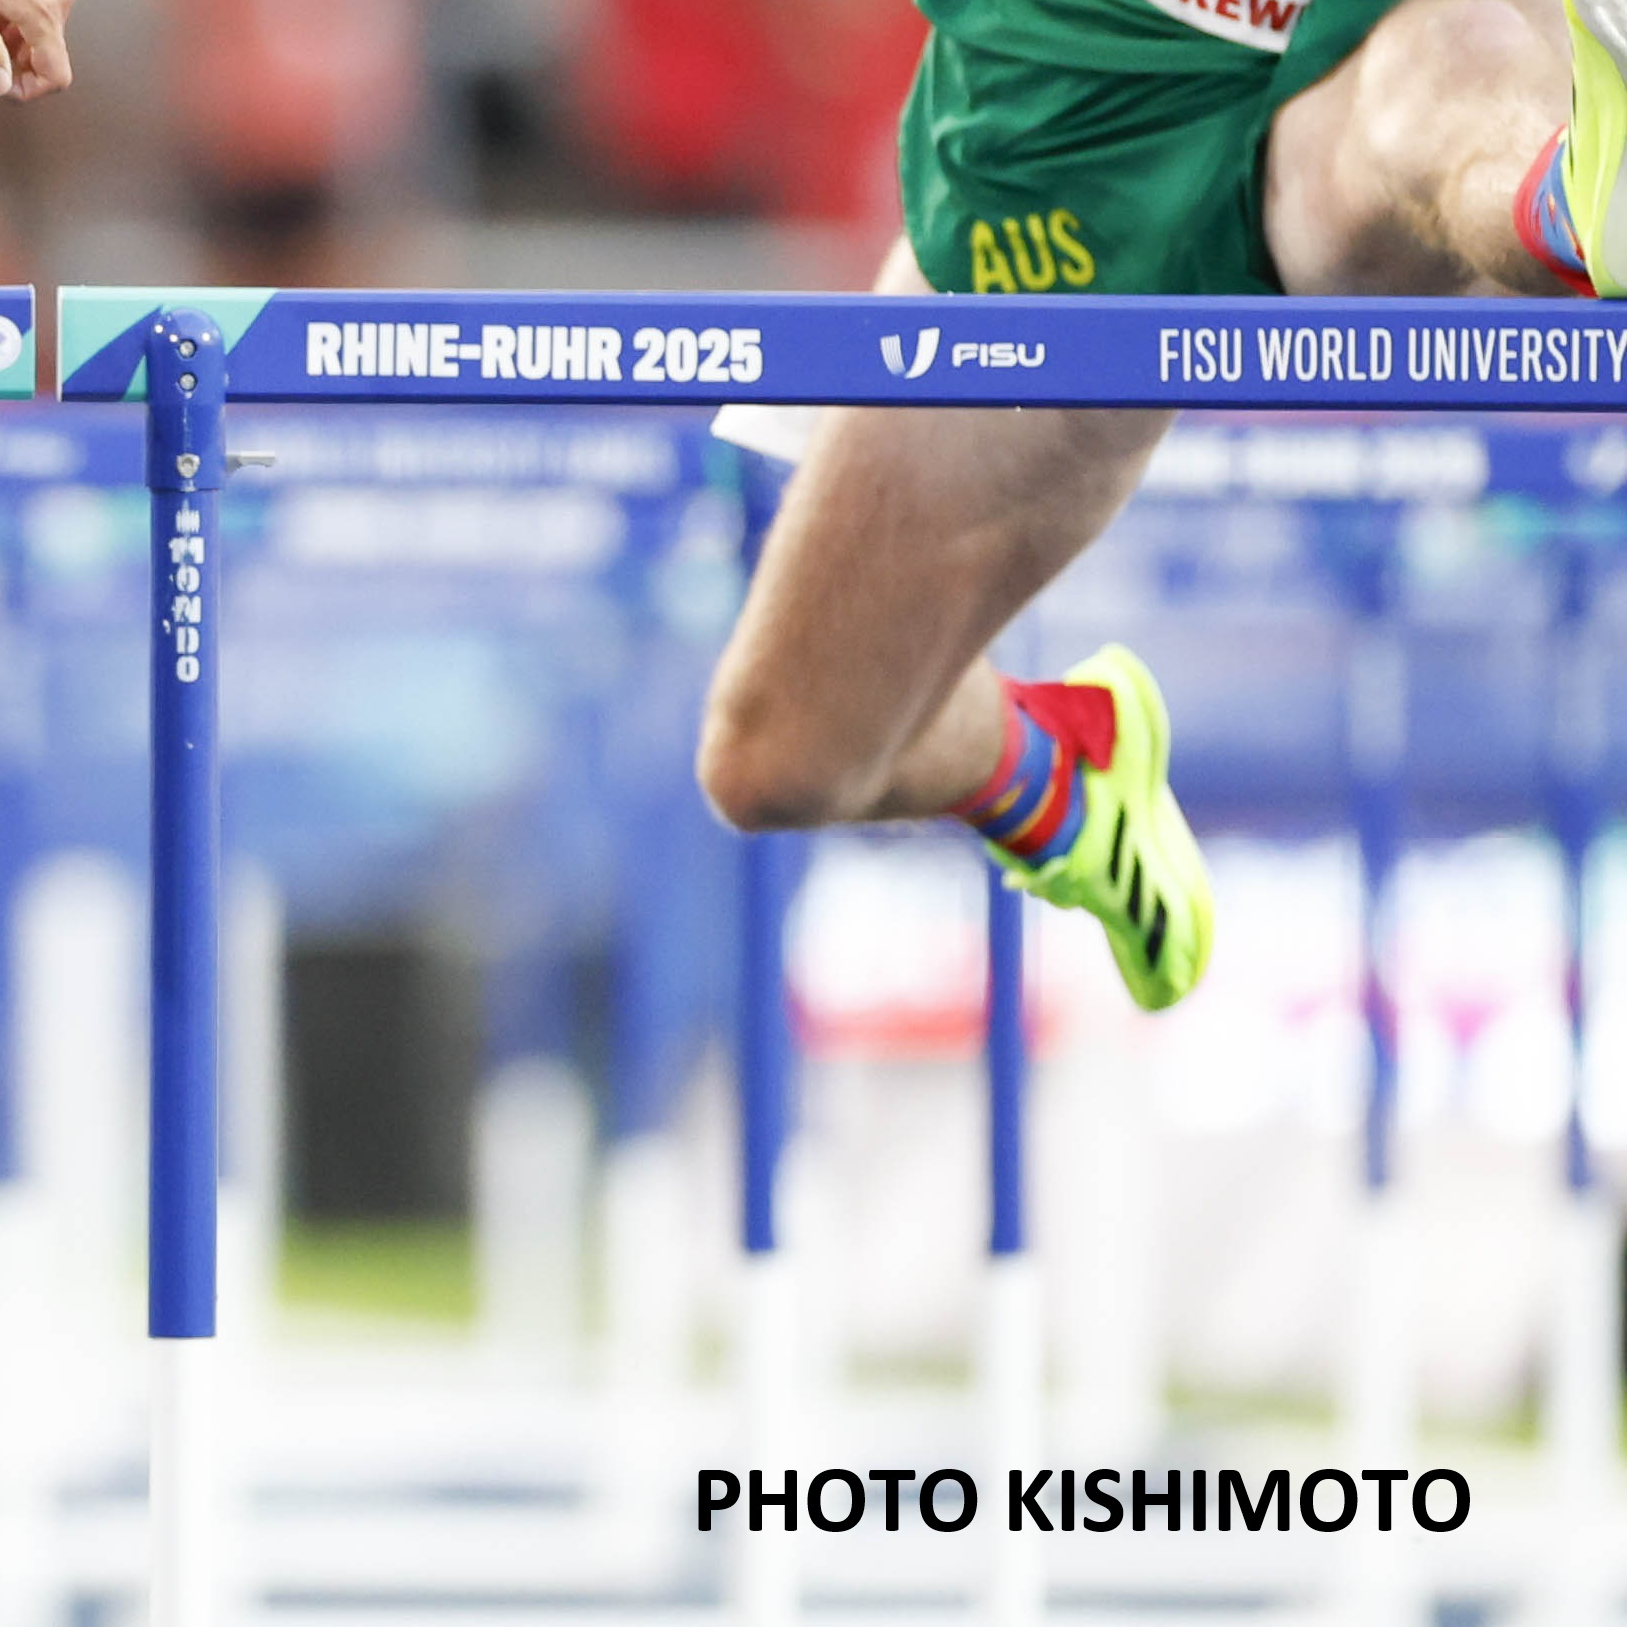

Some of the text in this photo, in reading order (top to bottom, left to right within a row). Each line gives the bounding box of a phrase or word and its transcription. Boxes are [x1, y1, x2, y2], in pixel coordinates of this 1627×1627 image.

[971, 207, 1095, 294] AUS
[306, 322, 763, 383] RHINE-RUHR 2025
[952, 342, 1045, 368] FISU
[1159, 327, 1627, 383] FISU WORLD UNIVERSITY
[168, 536, 205, 683] MONDO
